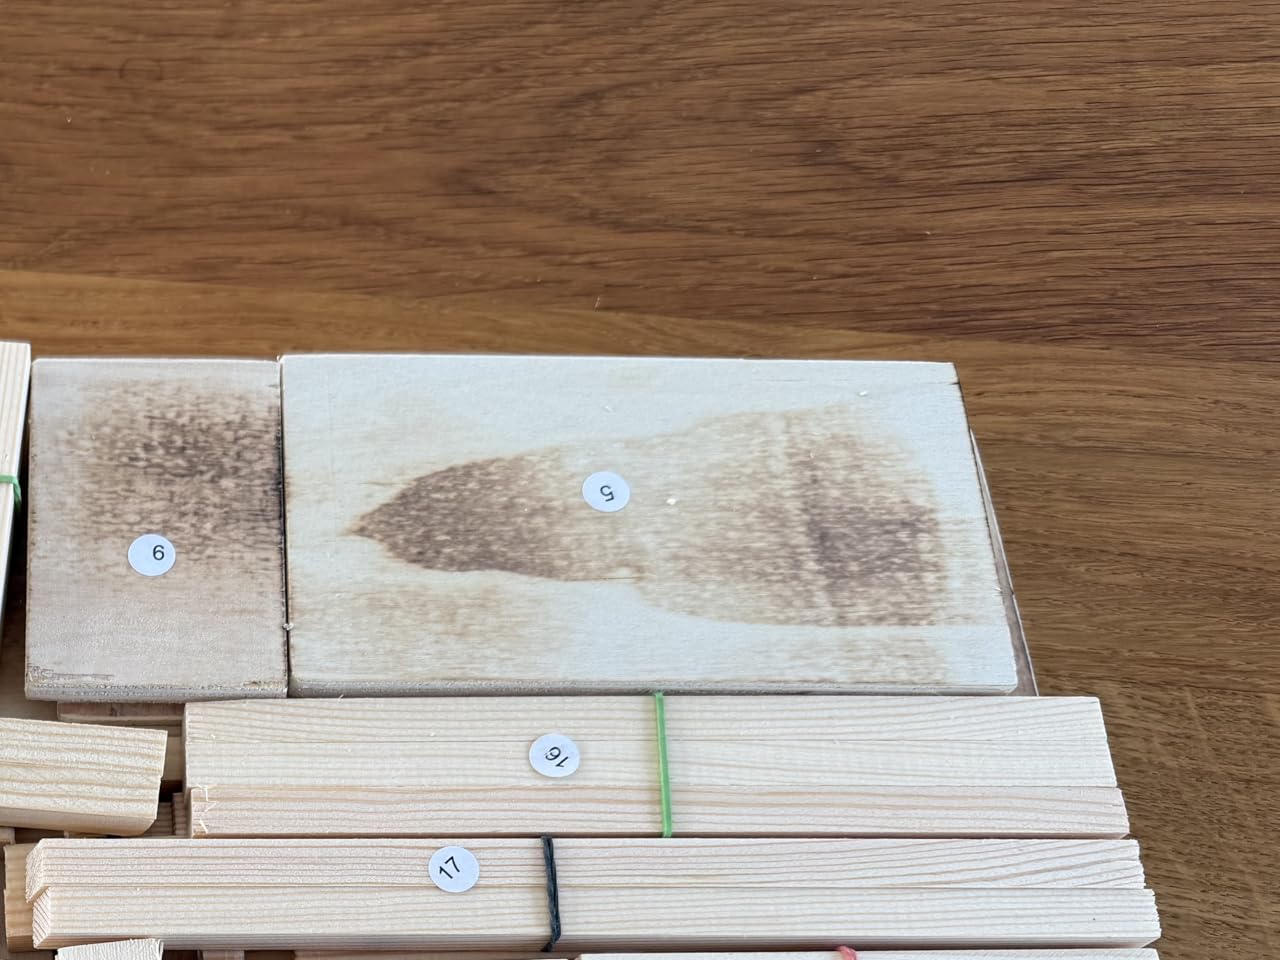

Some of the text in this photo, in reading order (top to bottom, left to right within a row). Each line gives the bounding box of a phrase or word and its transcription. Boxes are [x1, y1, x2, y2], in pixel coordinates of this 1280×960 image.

[600, 485, 615, 502] 5
[152, 544, 165, 561] 6
[545, 746, 570, 768] 16
[439, 855, 461, 879] 17
